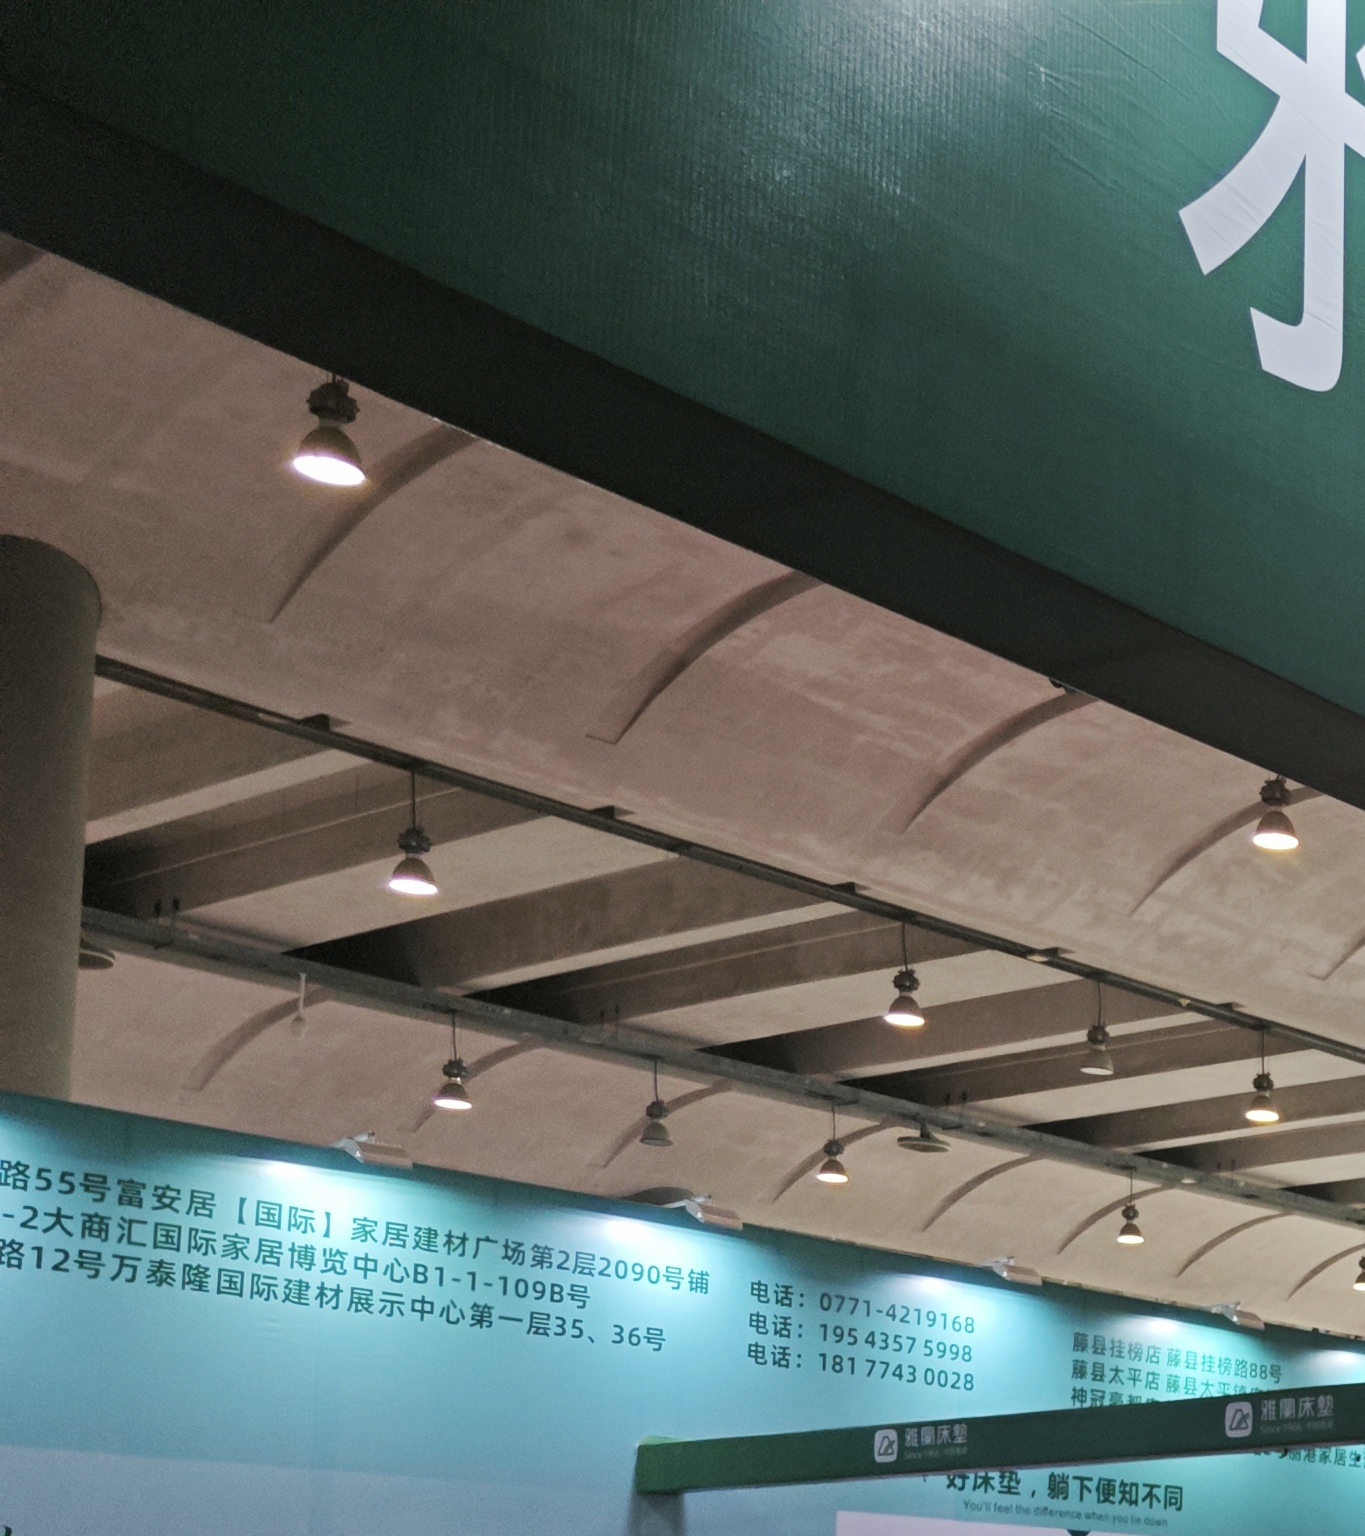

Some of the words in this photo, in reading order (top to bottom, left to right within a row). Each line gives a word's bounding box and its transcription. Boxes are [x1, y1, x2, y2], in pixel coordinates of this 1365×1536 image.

[819, 1292, 976, 1334] 0771-4219168
[1071, 1358, 1161, 1391] 藤县太平店
